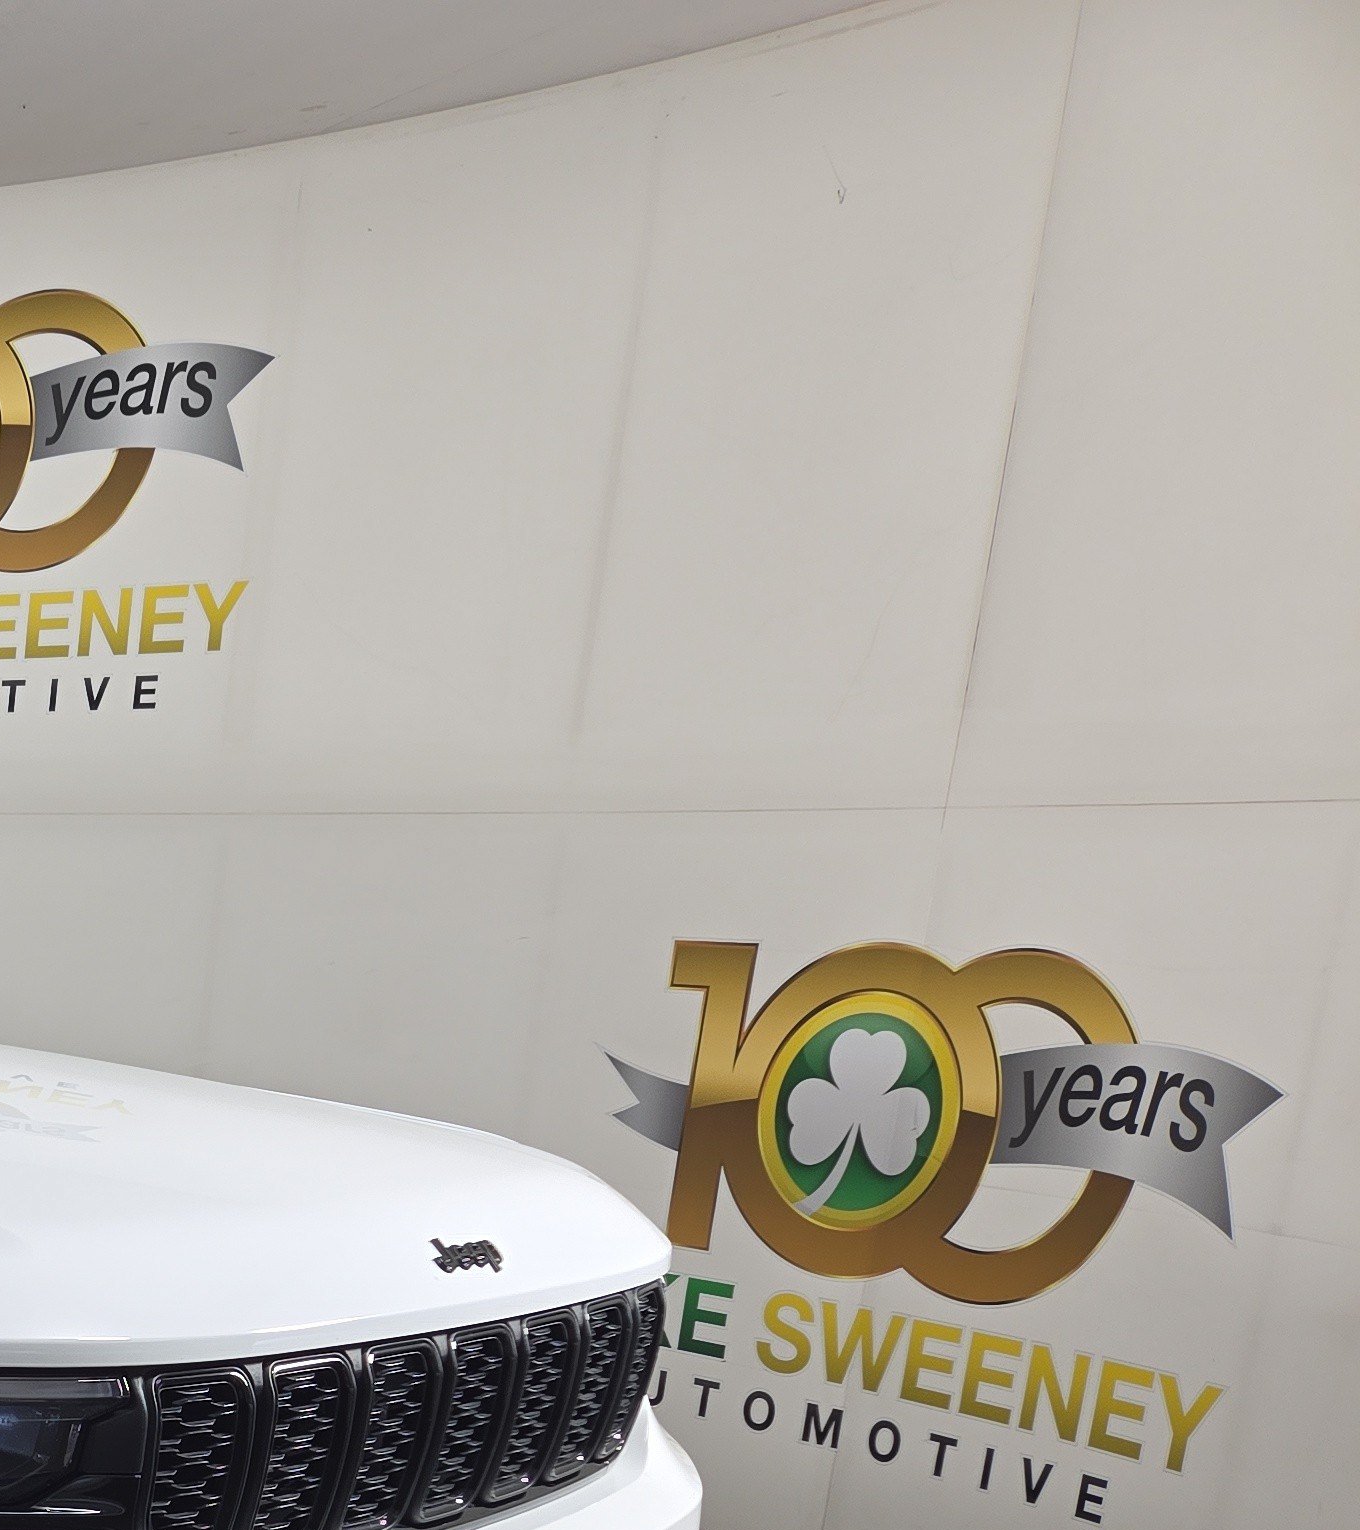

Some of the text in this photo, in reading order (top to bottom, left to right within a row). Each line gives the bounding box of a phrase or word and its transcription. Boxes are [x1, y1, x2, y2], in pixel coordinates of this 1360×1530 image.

[45, 359, 217, 446] years
[667, 940, 1138, 1305] 100
[1007, 1061, 1216, 1152] years
[429, 1238, 503, 1273] Jeep
[755, 1292, 1225, 1473] SWEENEY
[648, 1370, 1110, 1525] UTOMOTIVE
